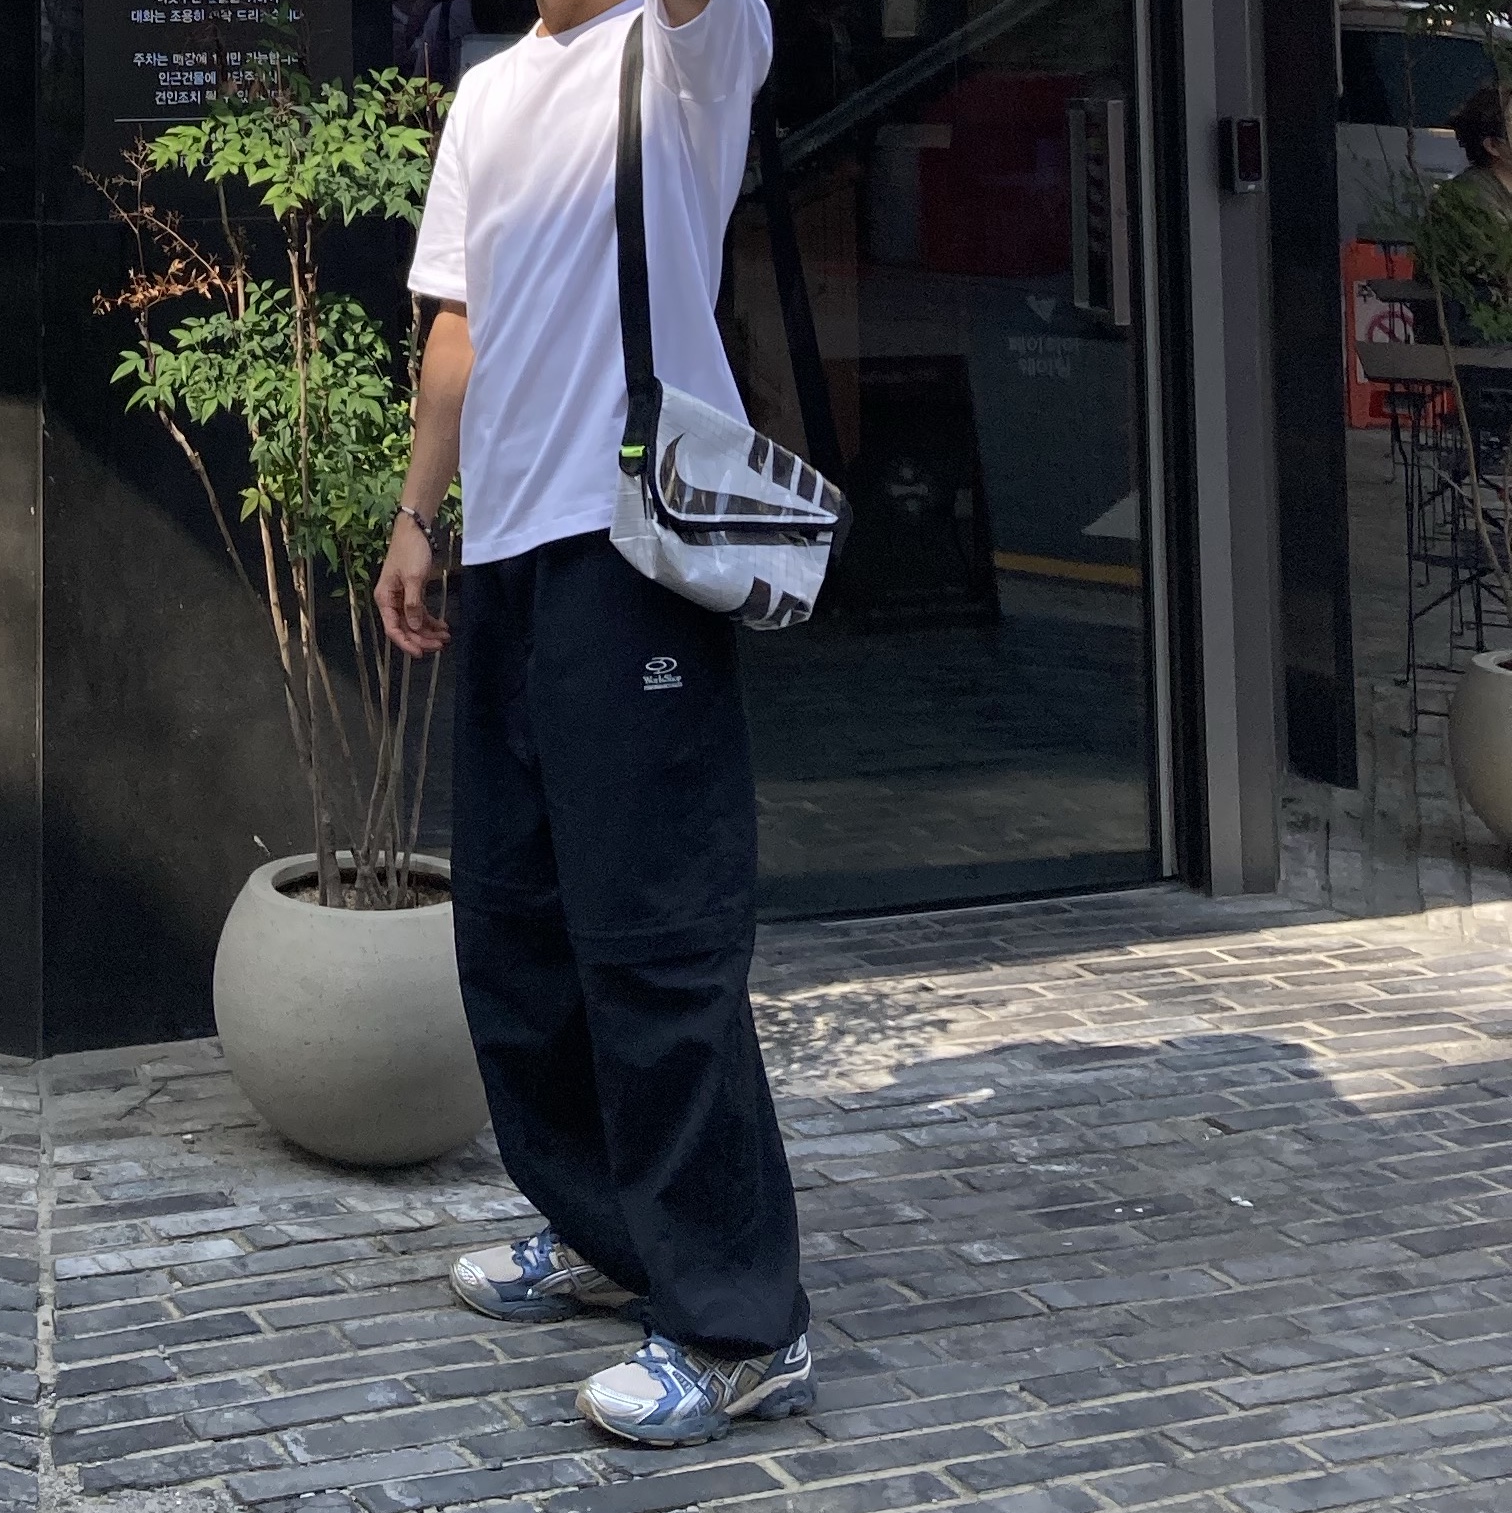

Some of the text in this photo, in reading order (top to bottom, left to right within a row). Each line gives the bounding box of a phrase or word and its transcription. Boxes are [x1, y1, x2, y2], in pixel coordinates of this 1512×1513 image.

[130, 9, 166, 24] 대화는
[169, 8, 205, 24] 조용히
[132, 52, 169, 67] 주차는
[158, 71, 217, 86] 인근건물에
[155, 90, 201, 105] 견인조치
